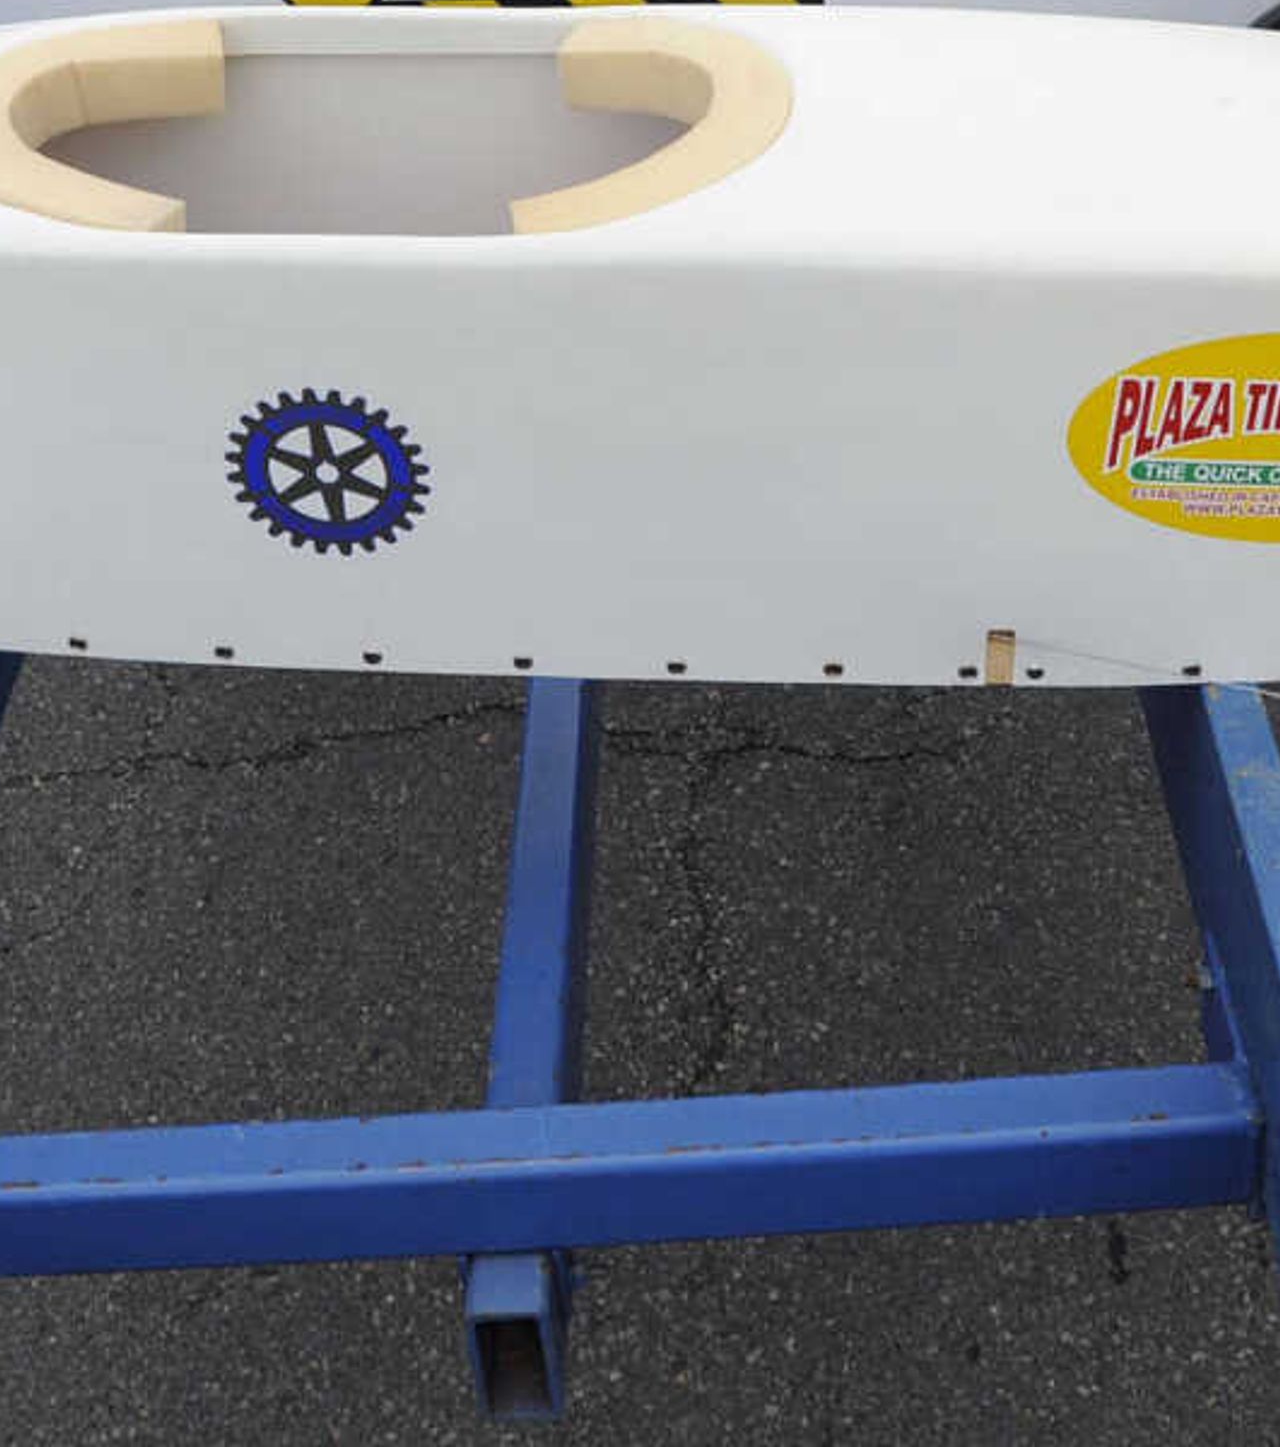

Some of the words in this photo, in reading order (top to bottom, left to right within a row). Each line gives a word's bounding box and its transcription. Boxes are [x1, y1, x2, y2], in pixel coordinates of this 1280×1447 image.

[1106, 377, 1232, 469] PLAZA
[1144, 464, 1187, 480] THE
[1193, 465, 1264, 483] QUICK
